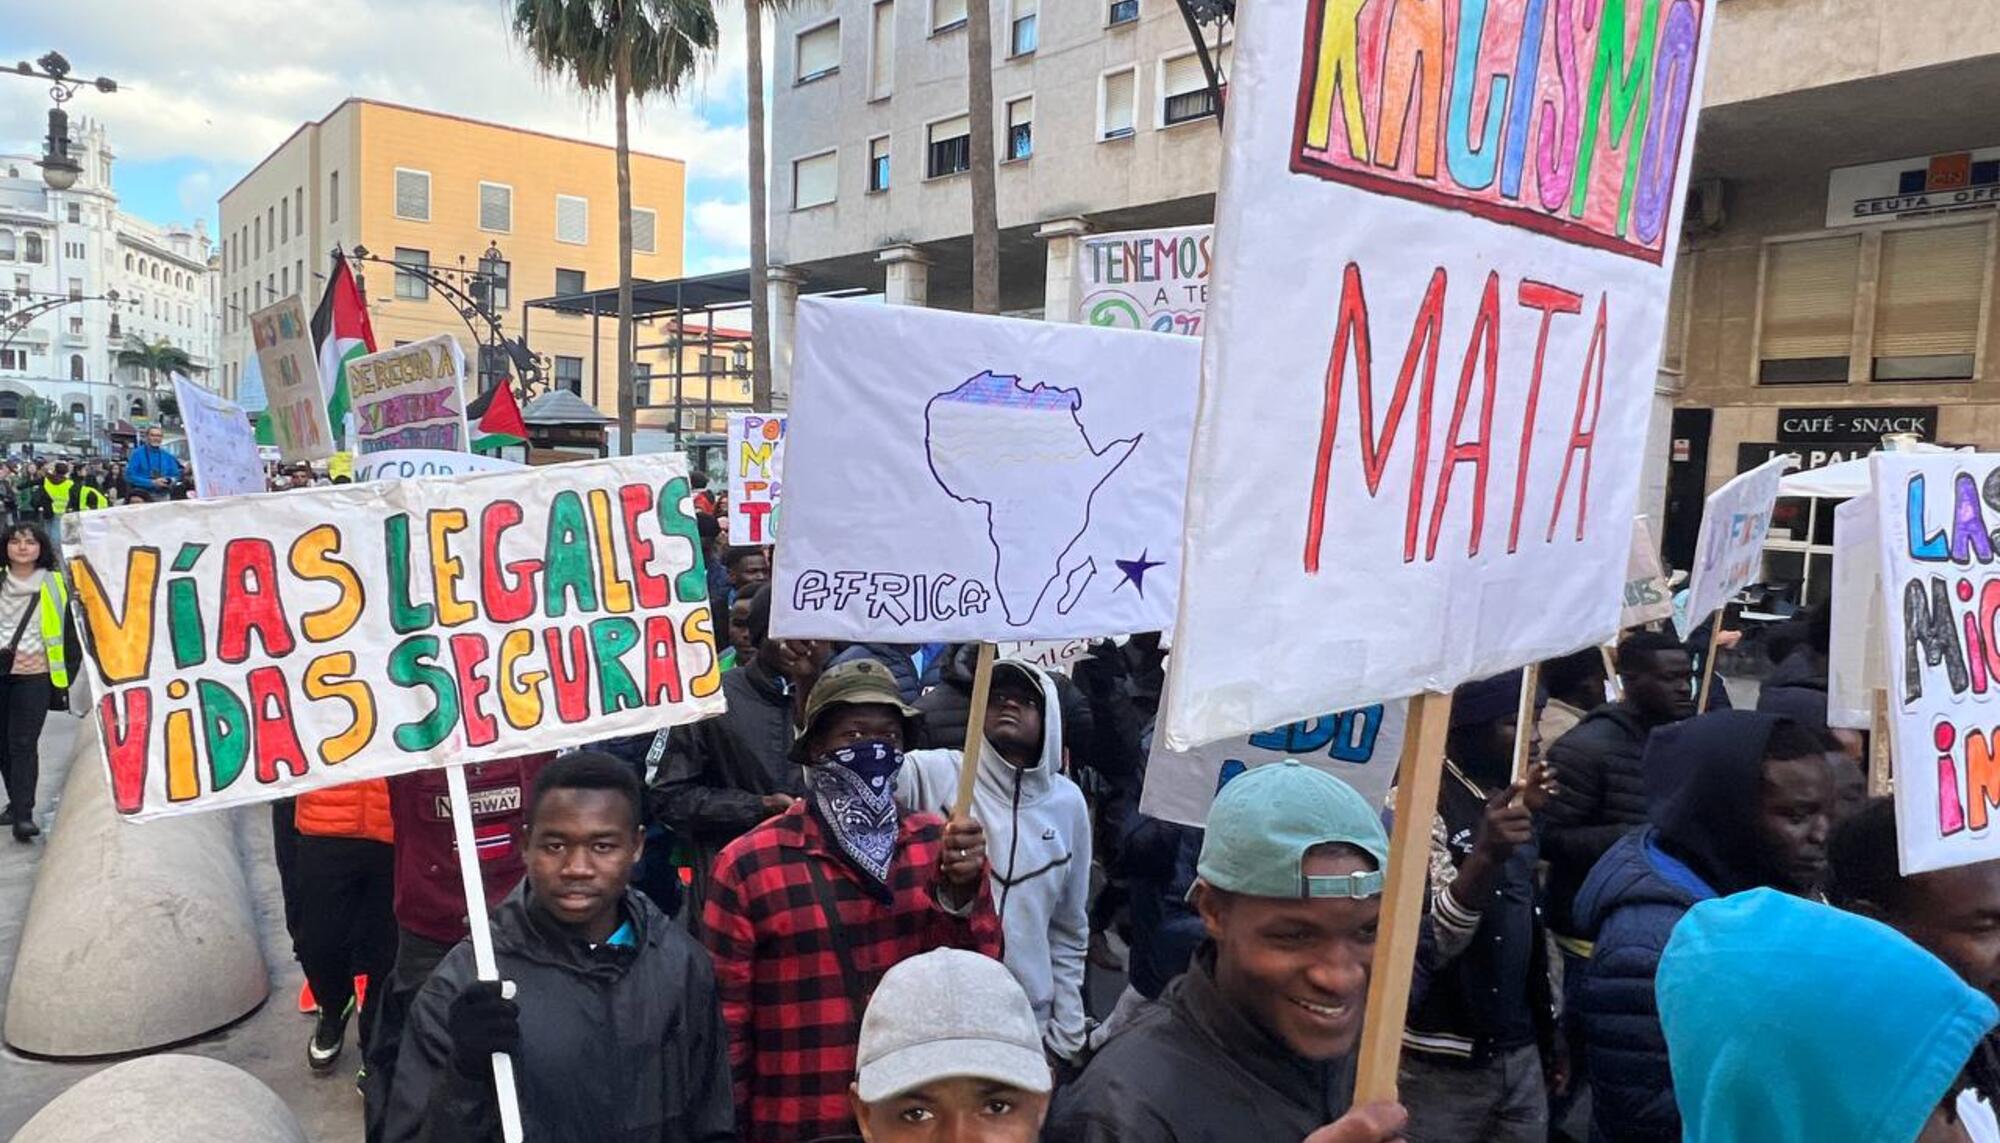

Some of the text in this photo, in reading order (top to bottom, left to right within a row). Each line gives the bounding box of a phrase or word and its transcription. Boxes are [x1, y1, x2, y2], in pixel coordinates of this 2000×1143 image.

[1305, 0, 1700, 244] RACISMO
[1853, 196, 1929, 214] CEUTA
[1085, 234, 1213, 284] TENEMOS
[1154, 287, 1169, 306] A
[351, 344, 456, 397] DERECHO A
[1304, 261, 1608, 574] MATA
[1783, 415, 1835, 433] CAFÉ
[1851, 416, 1926, 433] SNACK
[384, 476, 709, 635] LEGALES
[793, 569, 990, 626] AFRICA
[387, 606, 722, 752] SEGURAS
[438, 795, 518, 816] NRWAY
